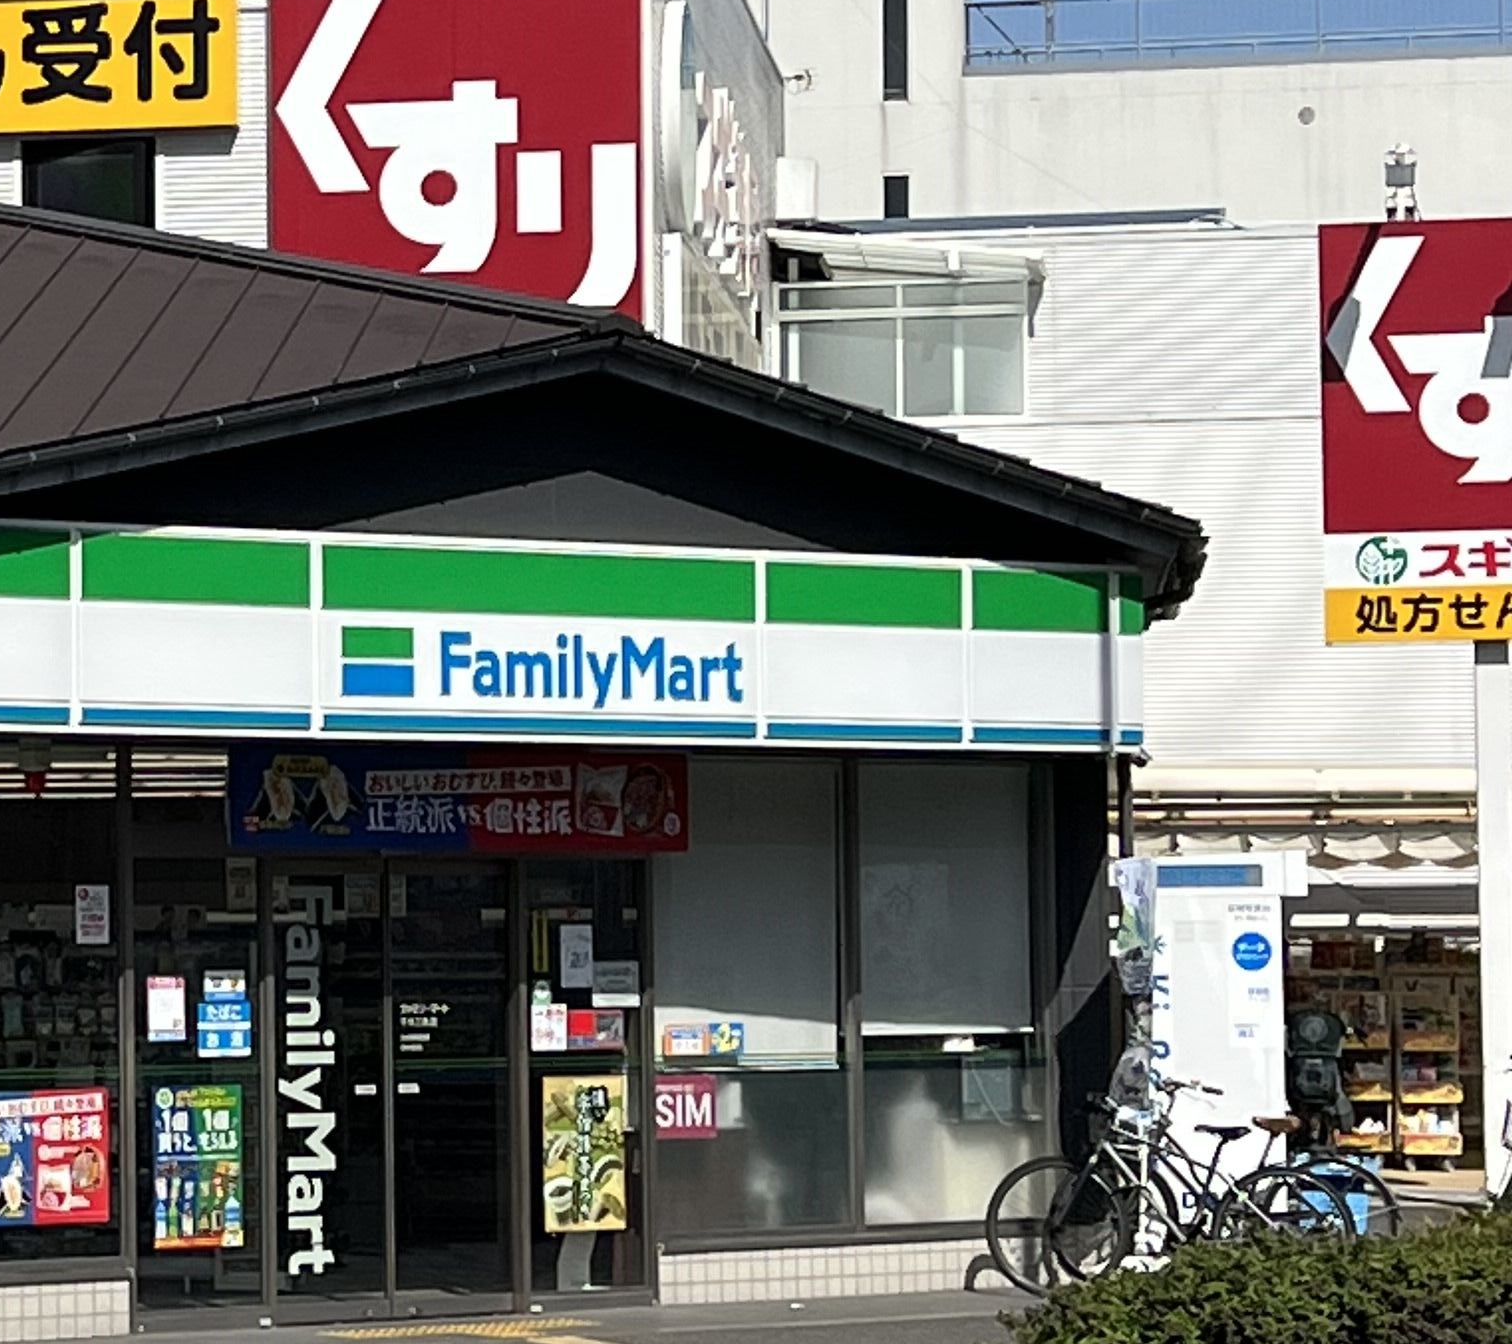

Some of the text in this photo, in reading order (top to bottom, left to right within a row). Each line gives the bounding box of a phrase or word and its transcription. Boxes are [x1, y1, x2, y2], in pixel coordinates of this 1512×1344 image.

[440, 631, 744, 709] FamilyMart
[277, 885, 337, 1277] FamilyMart
[655, 1092, 712, 1128] SIM
